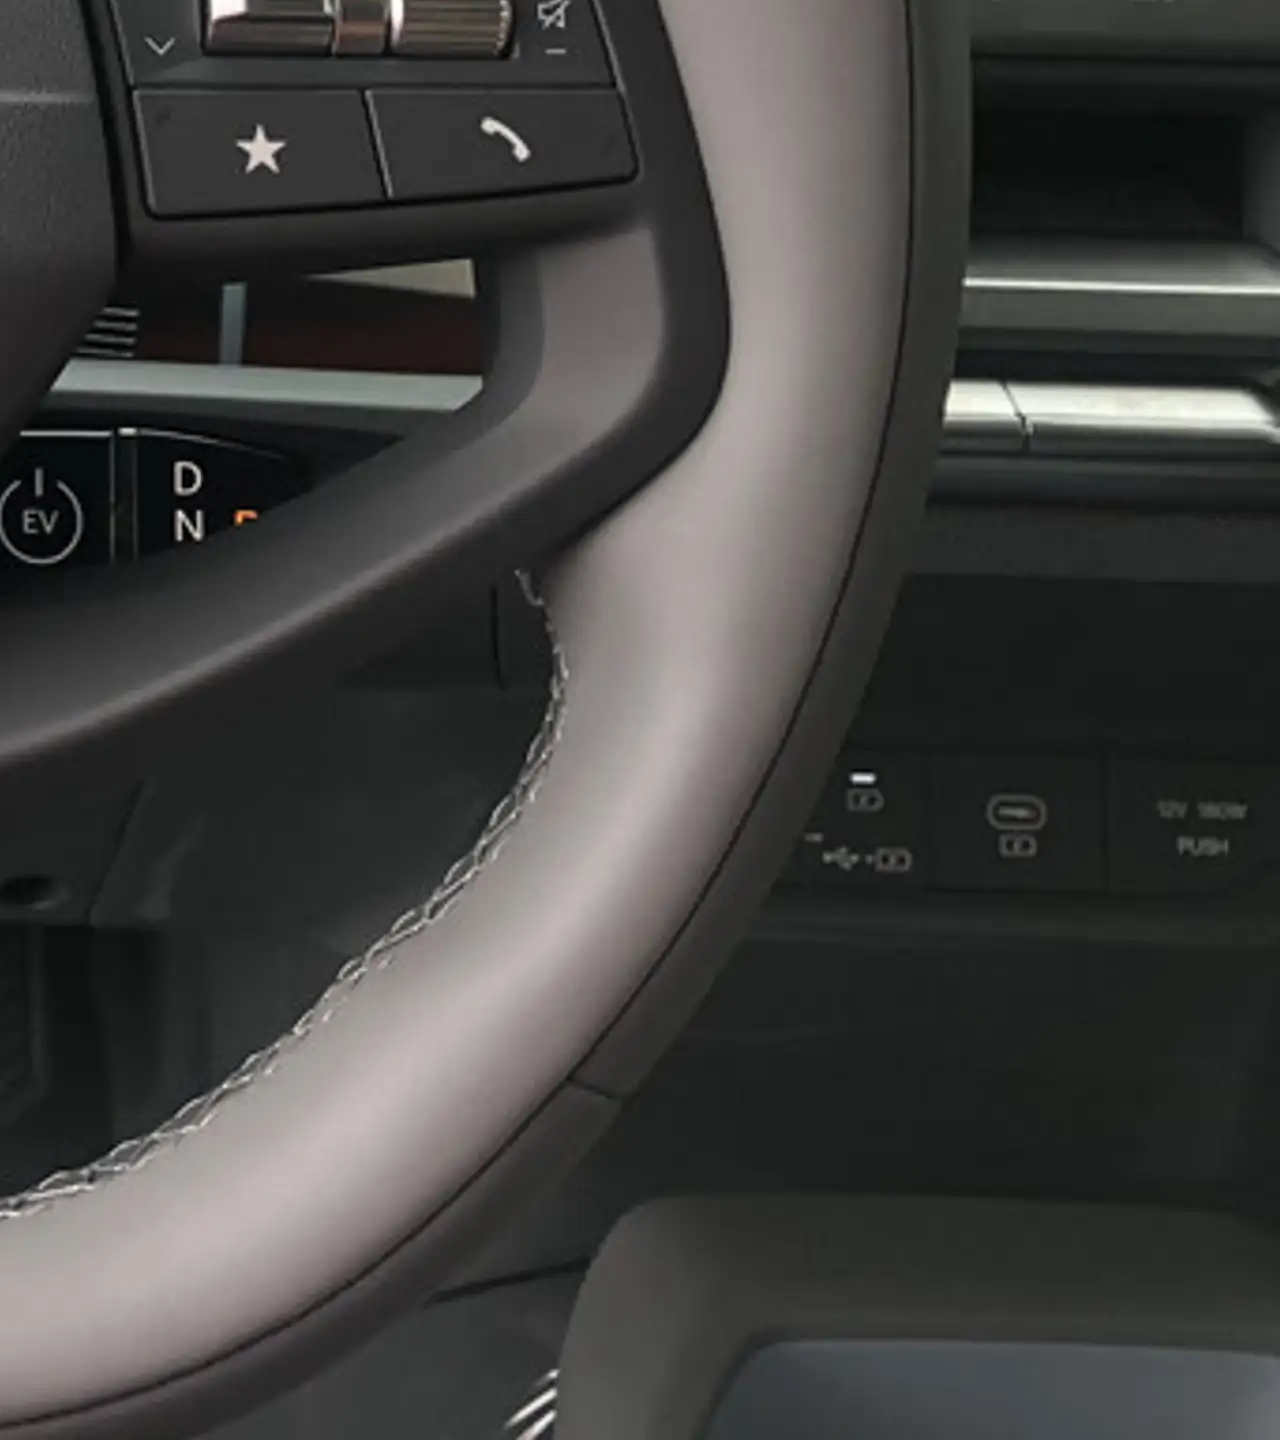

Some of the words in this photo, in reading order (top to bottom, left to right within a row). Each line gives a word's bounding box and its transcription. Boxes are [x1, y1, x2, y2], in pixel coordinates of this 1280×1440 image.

[173, 460, 203, 496] D
[22, 509, 59, 535] EV
[175, 509, 204, 542] N
[1177, 836, 1229, 858] PUSH
